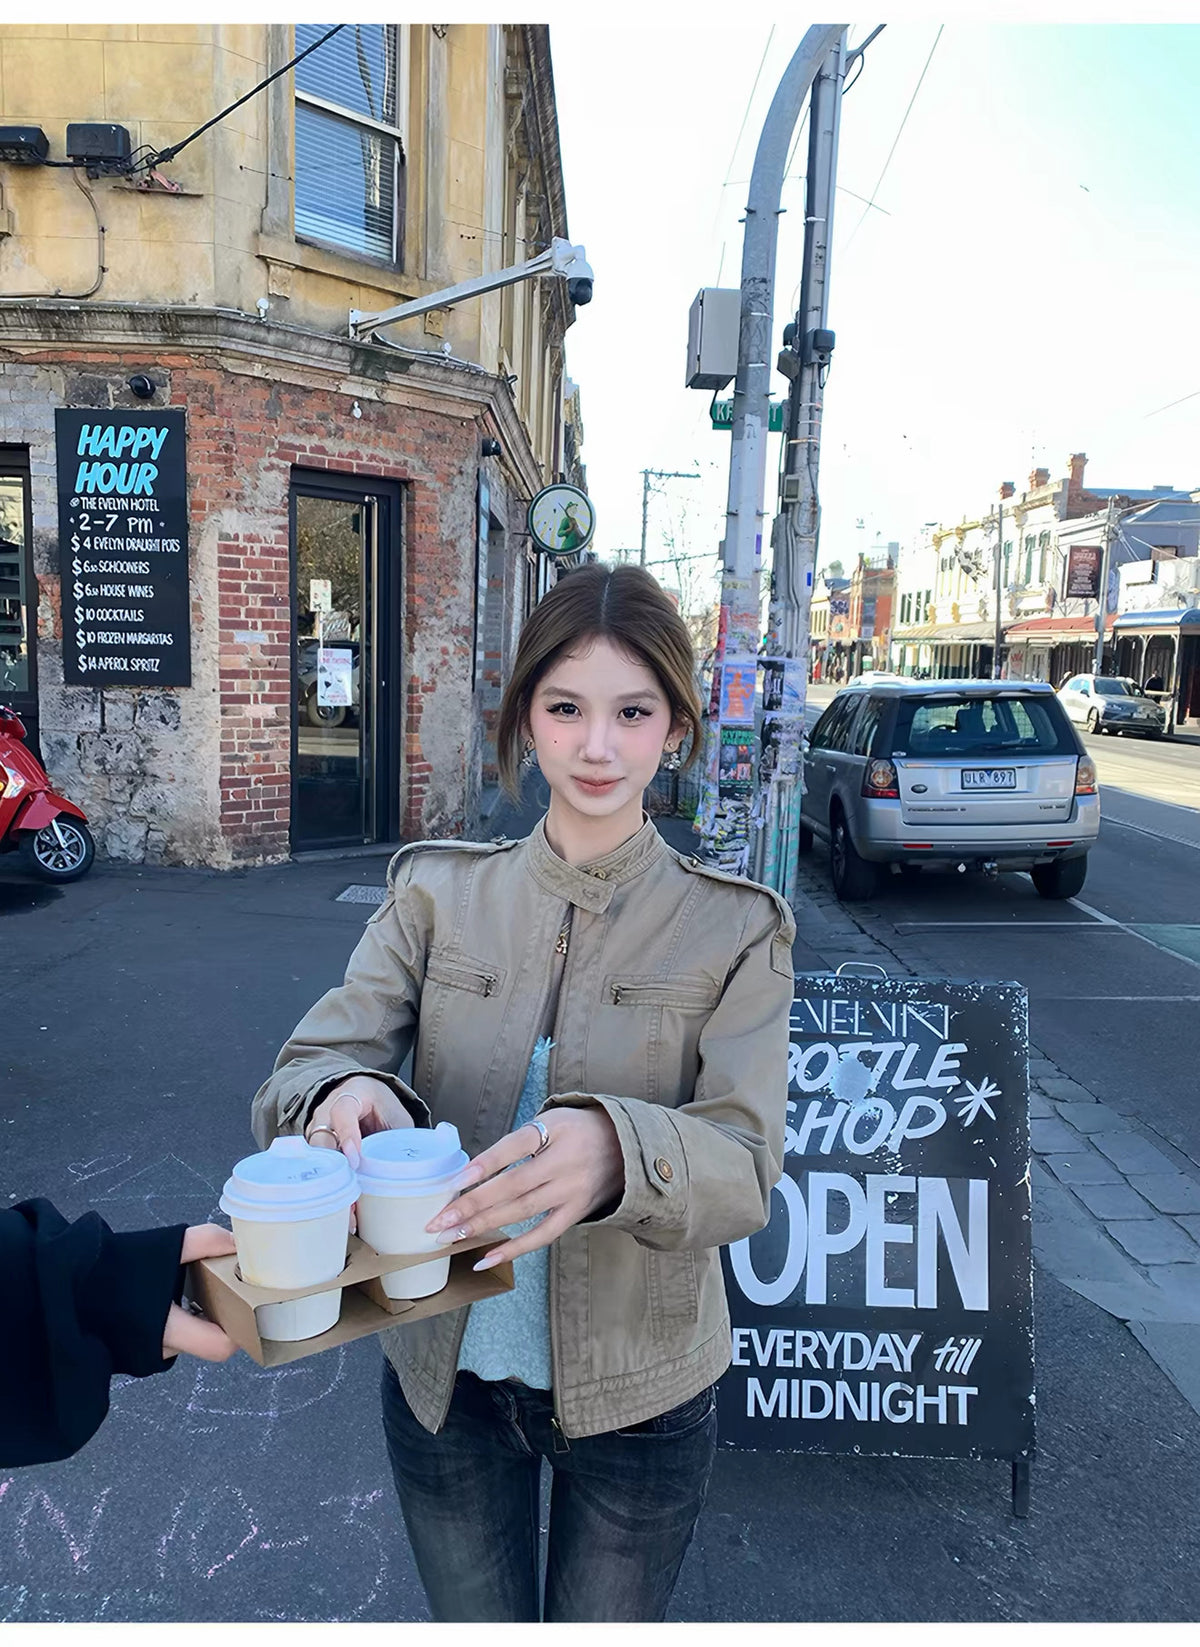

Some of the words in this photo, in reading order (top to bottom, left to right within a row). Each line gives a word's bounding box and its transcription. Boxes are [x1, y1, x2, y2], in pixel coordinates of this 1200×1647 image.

[77, 424, 169, 460] HAPPY
[74, 461, 159, 496] HOUR
[80, 496, 97, 510] THE
[98, 496, 129, 511] EVELYN
[130, 498, 160, 512] HOTEL
[93, 536, 125, 551] EVELYN
[126, 537, 161, 552] DRAUGHT
[161, 538, 181, 553] POTS
[98, 560, 150, 574] SCHOONERS
[100, 584, 126, 598] HOUSE
[127, 585, 155, 599] WINES
[96, 608, 145, 622] COCKTAILS
[97, 631, 125, 645] FROZEN
[98, 656, 129, 672] APEROL
[130, 657, 160, 673] SPRITZ
[729, 1171, 989, 1311] OPEN
[732, 1327, 923, 1373] EVERYDAY
[933, 1337, 983, 1376] till
[746, 1377, 979, 1426] MIDNIGHT
